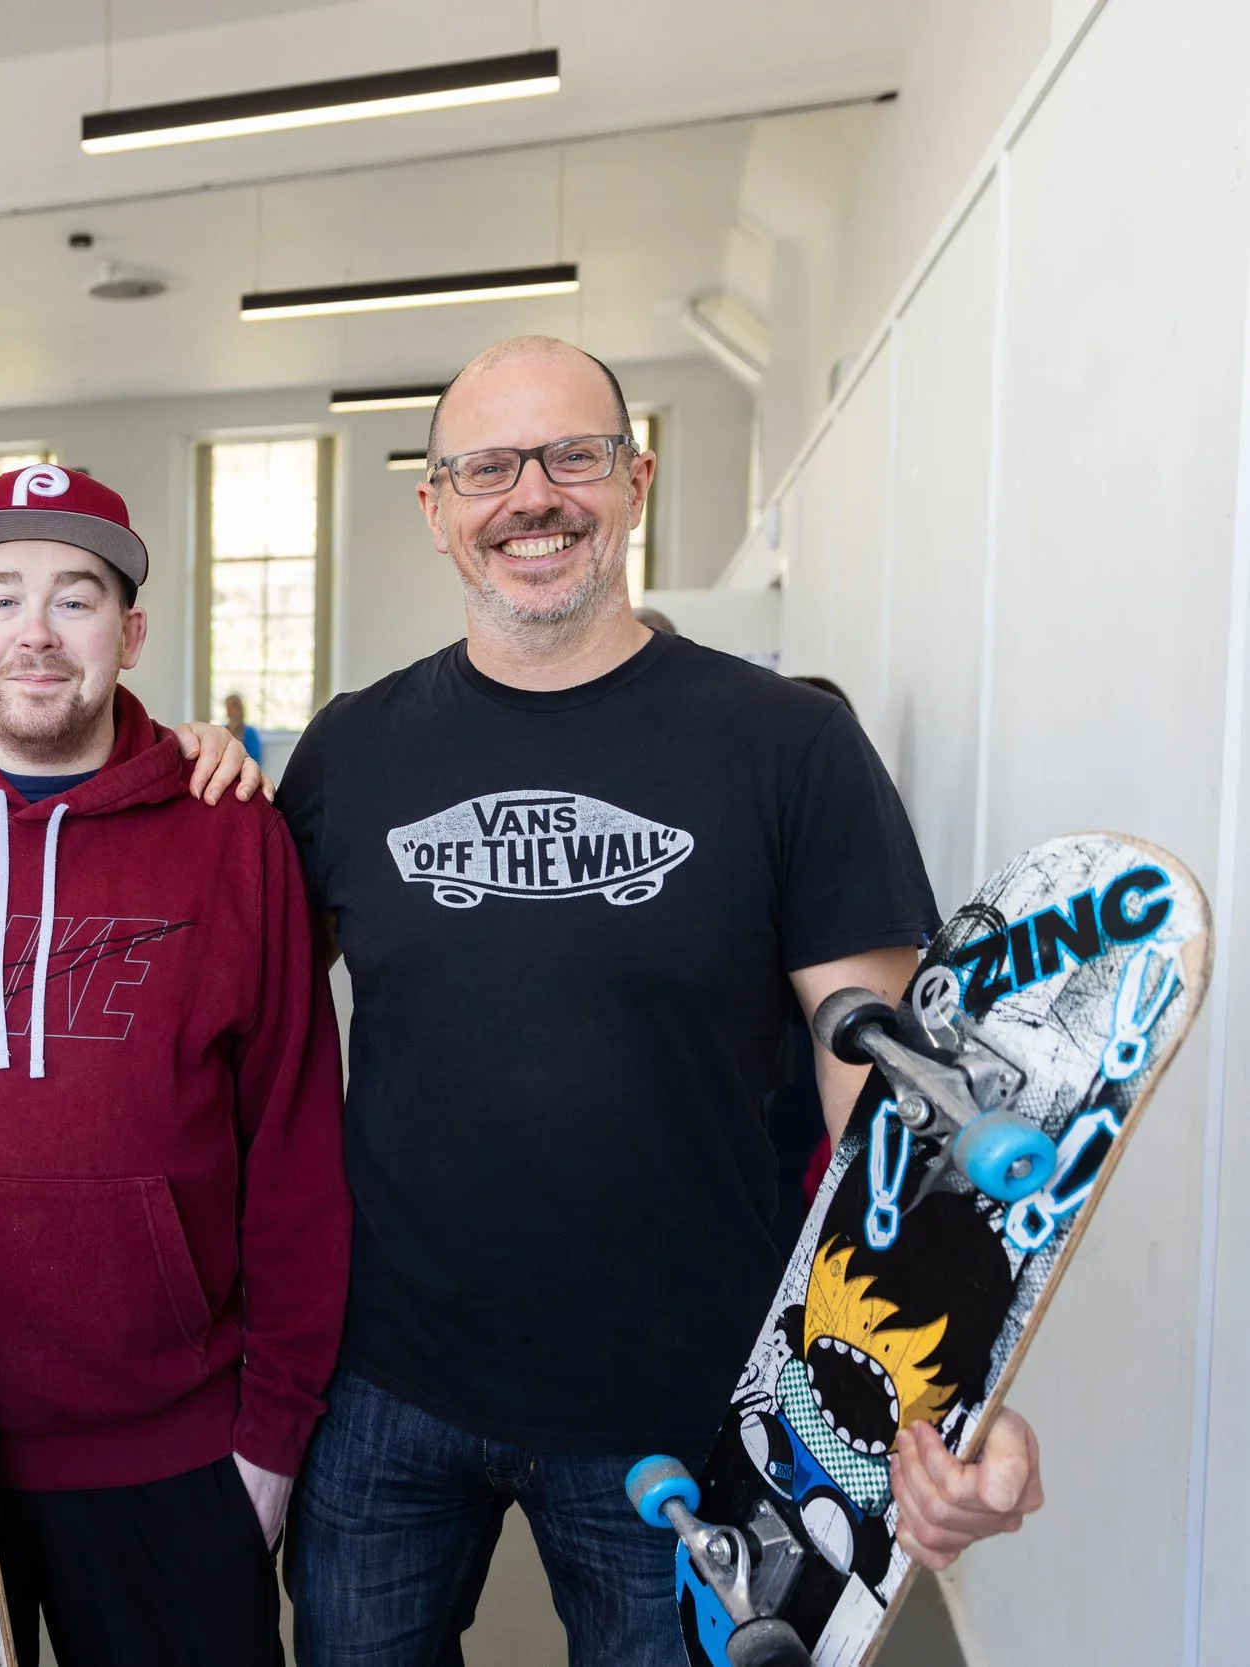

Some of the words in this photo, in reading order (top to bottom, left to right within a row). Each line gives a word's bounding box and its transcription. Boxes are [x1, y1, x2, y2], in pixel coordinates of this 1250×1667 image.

[11, 463, 71, 506] P
[471, 796, 577, 837] VANS
[481, 838, 559, 887] THE
[952, 865, 1174, 1016] ZINC
